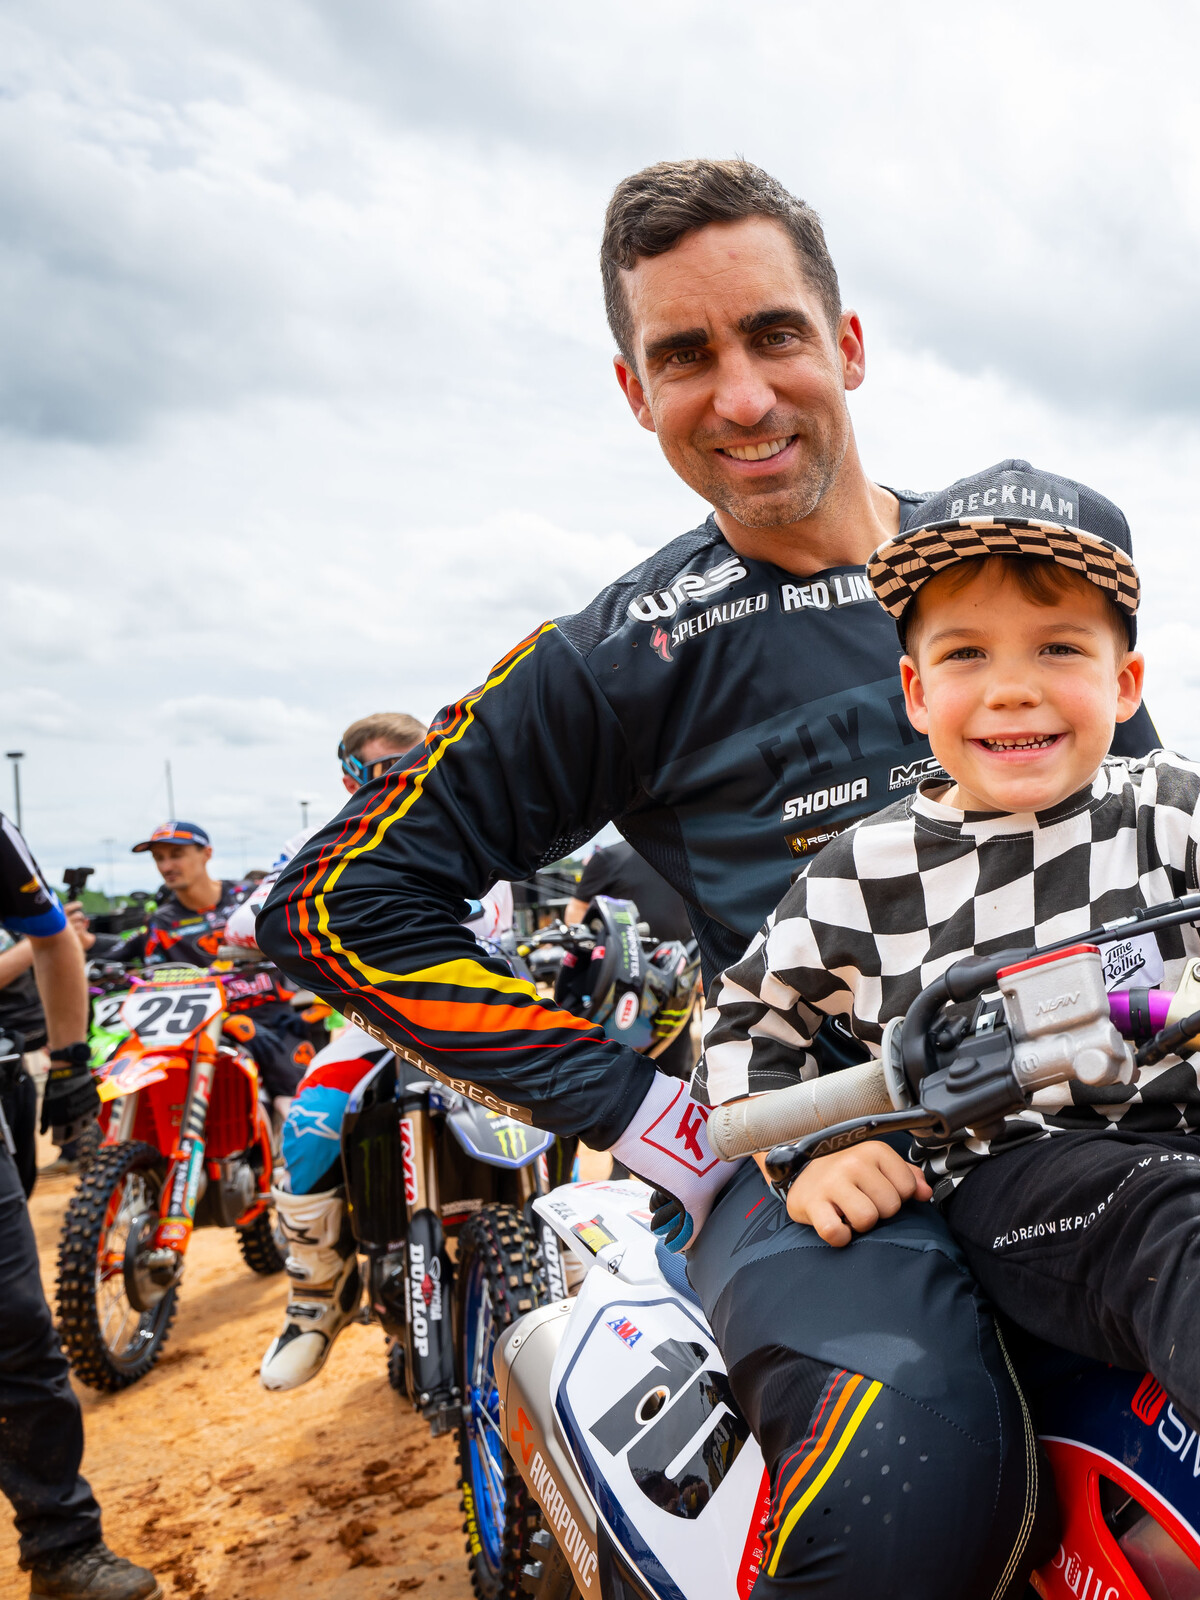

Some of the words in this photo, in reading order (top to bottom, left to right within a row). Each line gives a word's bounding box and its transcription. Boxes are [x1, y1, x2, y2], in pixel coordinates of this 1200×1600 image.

[950, 485, 1074, 520] BECKHAM
[628, 557, 747, 621] WPS
[781, 582, 829, 611] RED
[671, 594, 767, 647] SPECIALIZED
[756, 706, 865, 784] FLY
[783, 778, 868, 821] SHOWA
[135, 994, 213, 1037] 25
[386, 1038, 439, 1079] THE
[410, 1243, 429, 1358] DUNLOP
[606, 1316, 643, 1348] AMA
[589, 1338, 752, 1520] 10
[529, 1451, 598, 1588] AKRAPOVIČ
